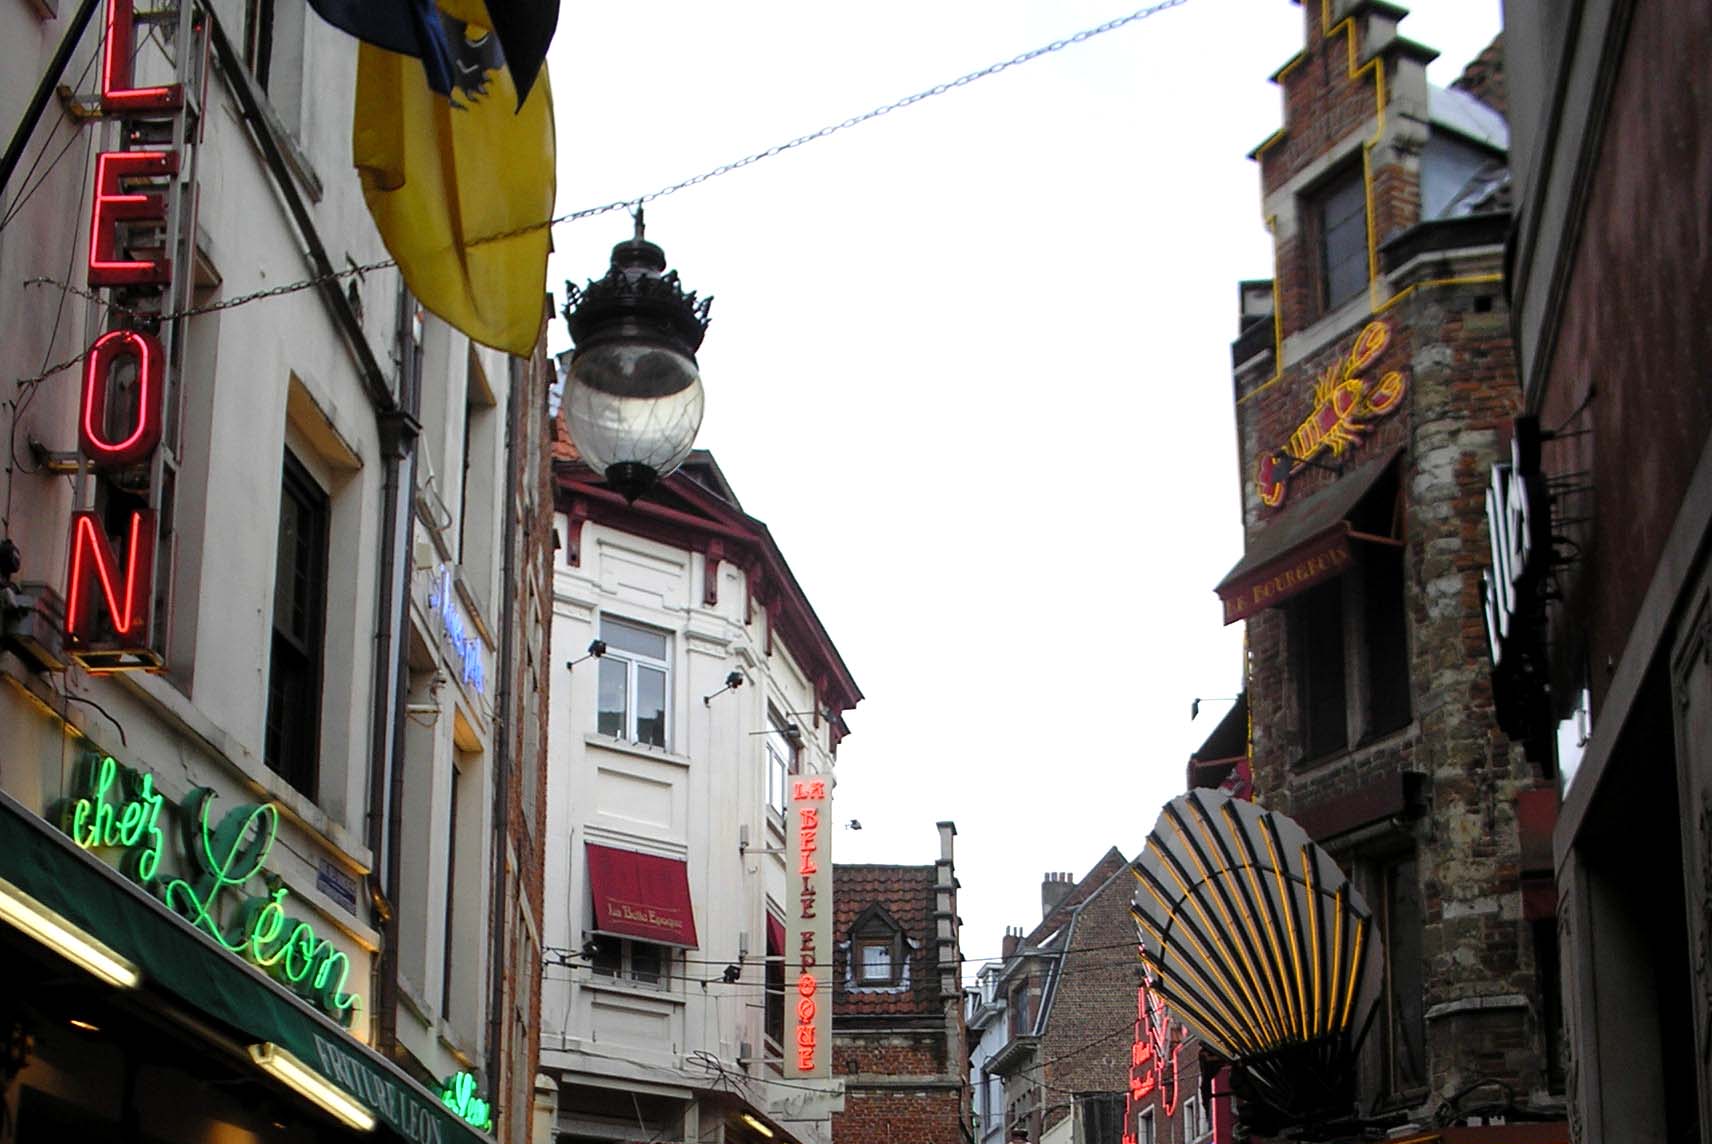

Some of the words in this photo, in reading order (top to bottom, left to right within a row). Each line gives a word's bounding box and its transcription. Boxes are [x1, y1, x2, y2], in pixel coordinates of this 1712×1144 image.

[67, 0, 183, 652] LEON
[73, 757, 164, 882] chez
[794, 779, 825, 800] LA
[799, 807, 819, 920] BELLE
[797, 930, 818, 1073] EPOQUE
